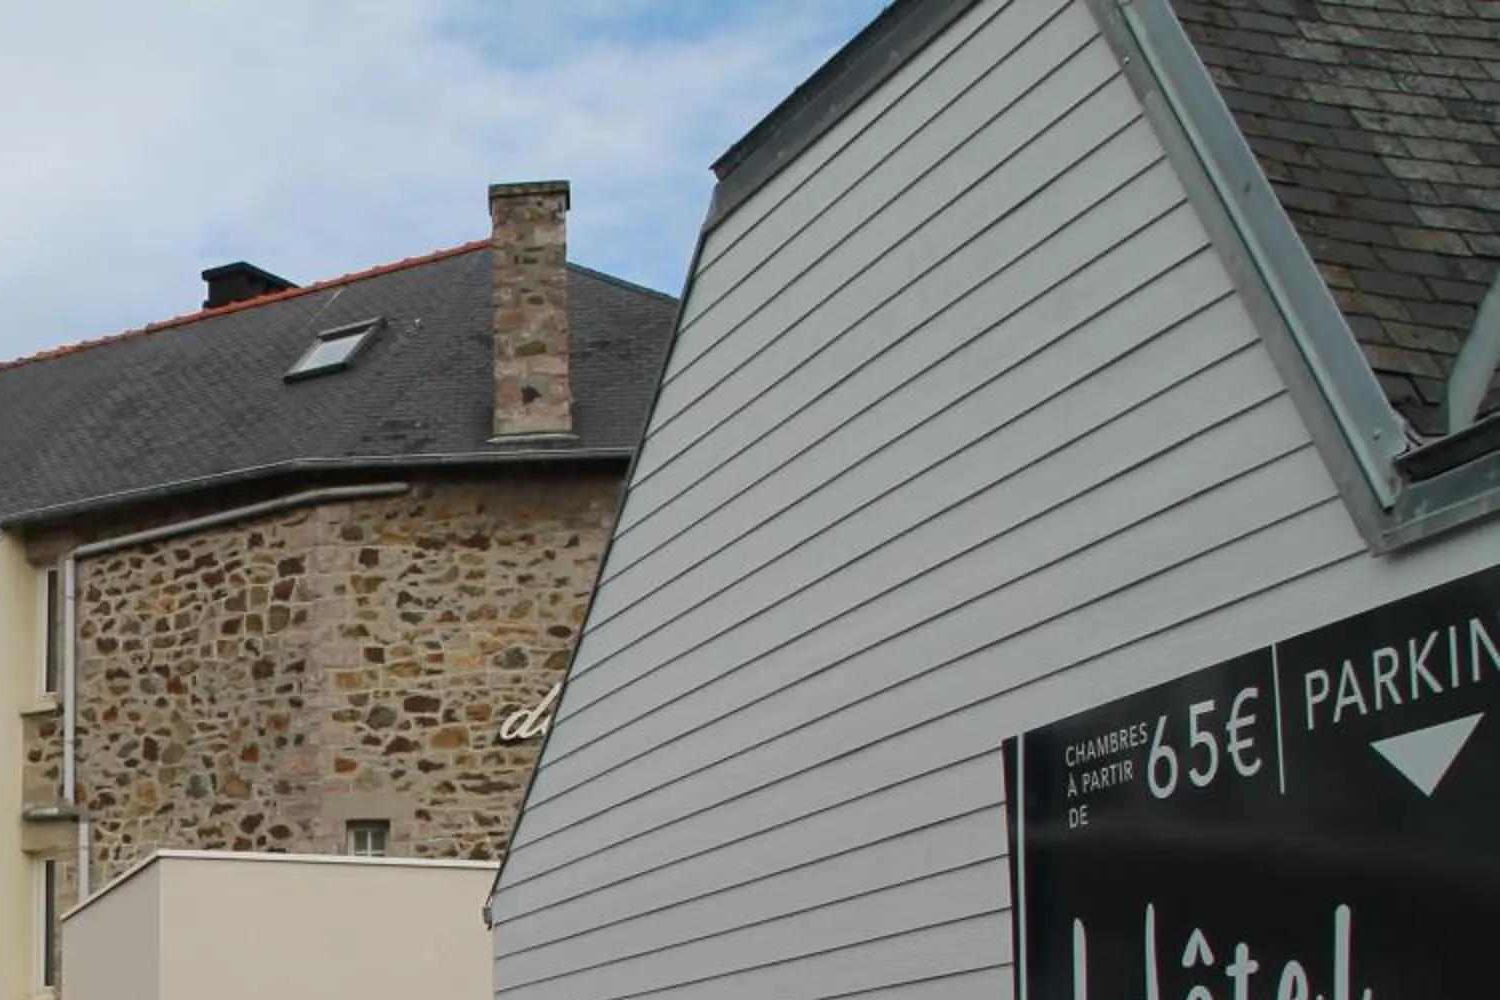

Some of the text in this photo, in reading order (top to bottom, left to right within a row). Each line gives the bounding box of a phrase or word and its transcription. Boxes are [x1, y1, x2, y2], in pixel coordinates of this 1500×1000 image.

[1065, 722, 1149, 767] CHAMBRES
[1147, 687, 1262, 799] 65€
[1082, 760, 1133, 793] PARTIR
[1069, 804, 1089, 829] DE
